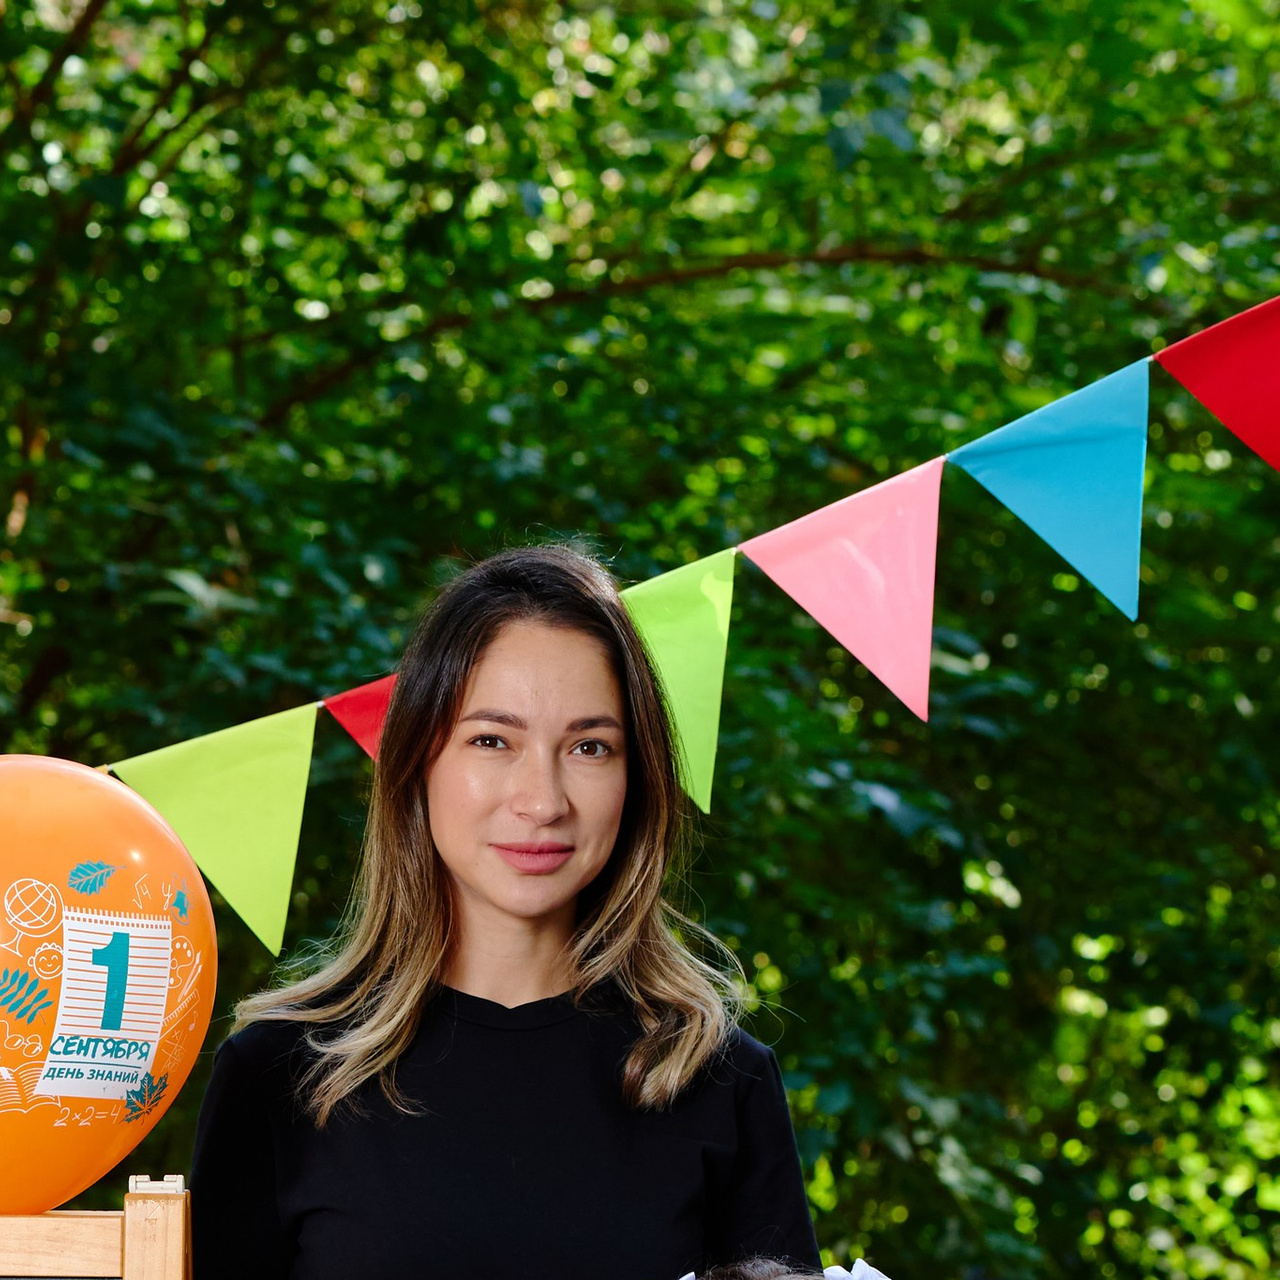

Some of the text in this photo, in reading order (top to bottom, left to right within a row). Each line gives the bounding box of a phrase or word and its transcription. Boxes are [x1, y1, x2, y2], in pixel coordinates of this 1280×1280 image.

[91, 931, 130, 1031] 1
[49, 1035, 152, 1062] СЕНТЯБРЯ
[43, 1066, 139, 1084] ДЕНЬ ЗНАНИЙ
